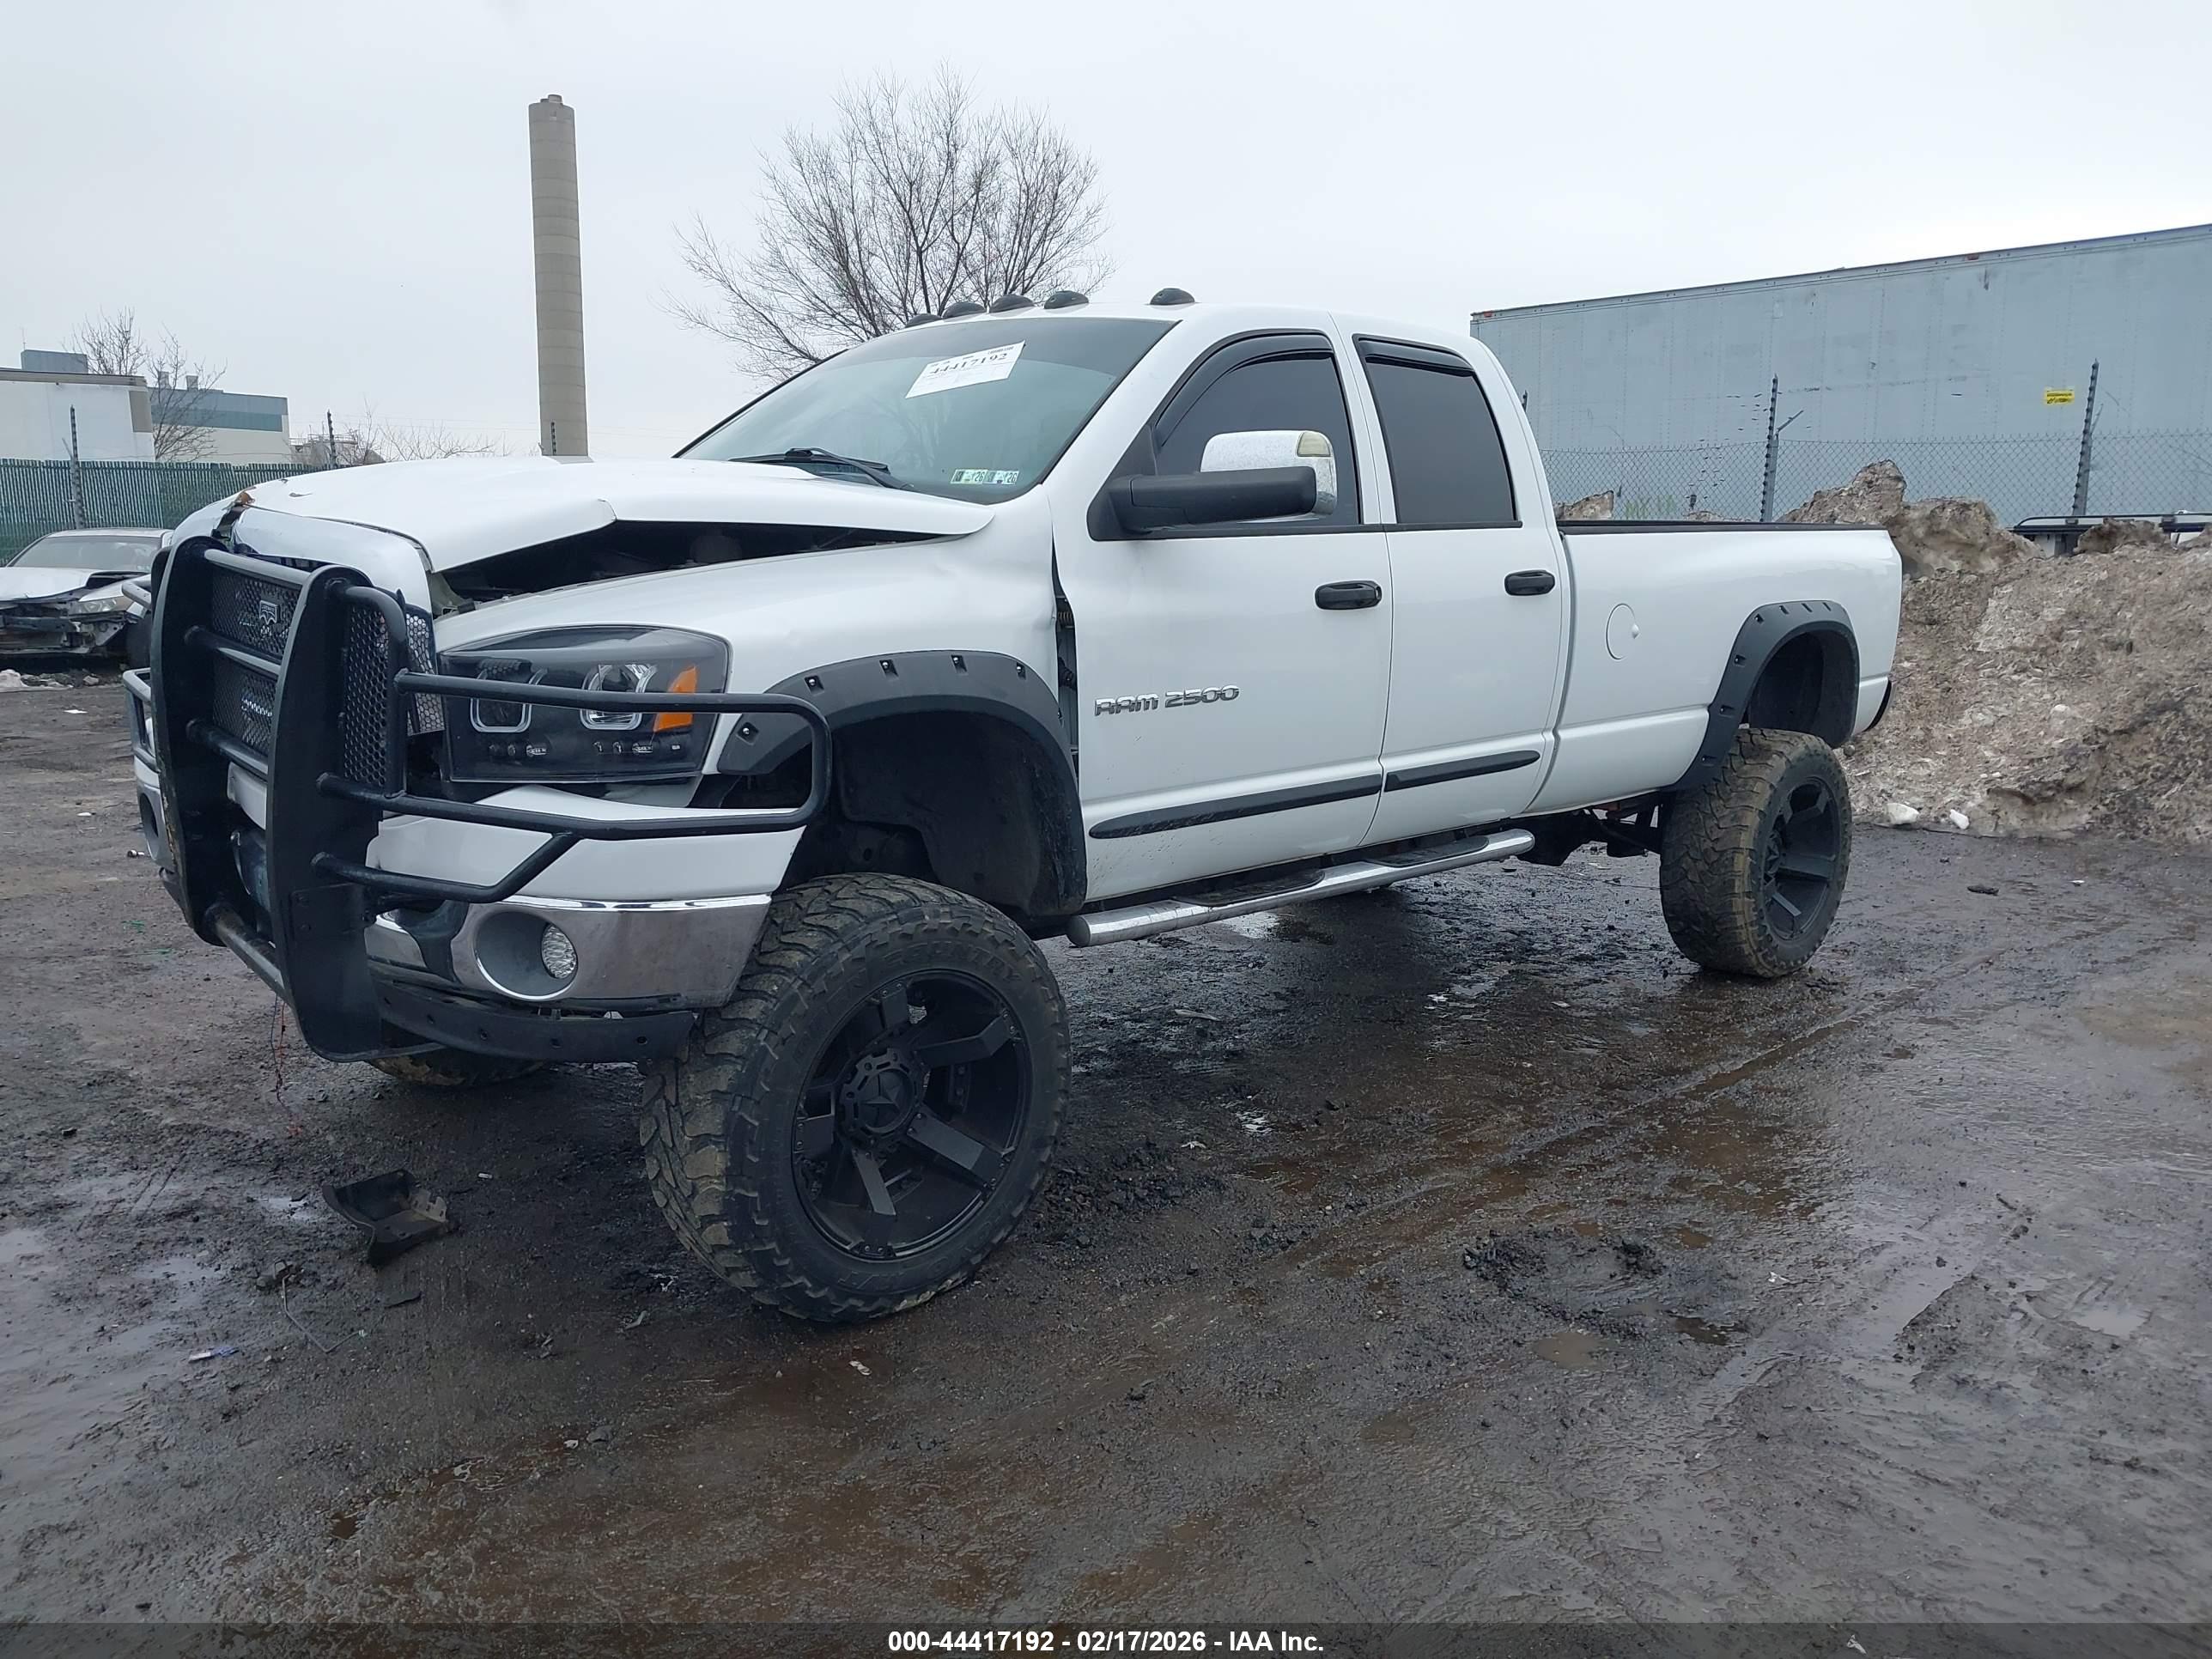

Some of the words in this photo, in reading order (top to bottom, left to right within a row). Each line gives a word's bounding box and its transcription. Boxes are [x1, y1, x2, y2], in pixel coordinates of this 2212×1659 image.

[930, 353, 1007, 374] 44417192
[1095, 693, 1159, 716] RAM
[1164, 684, 1239, 708] 2500
